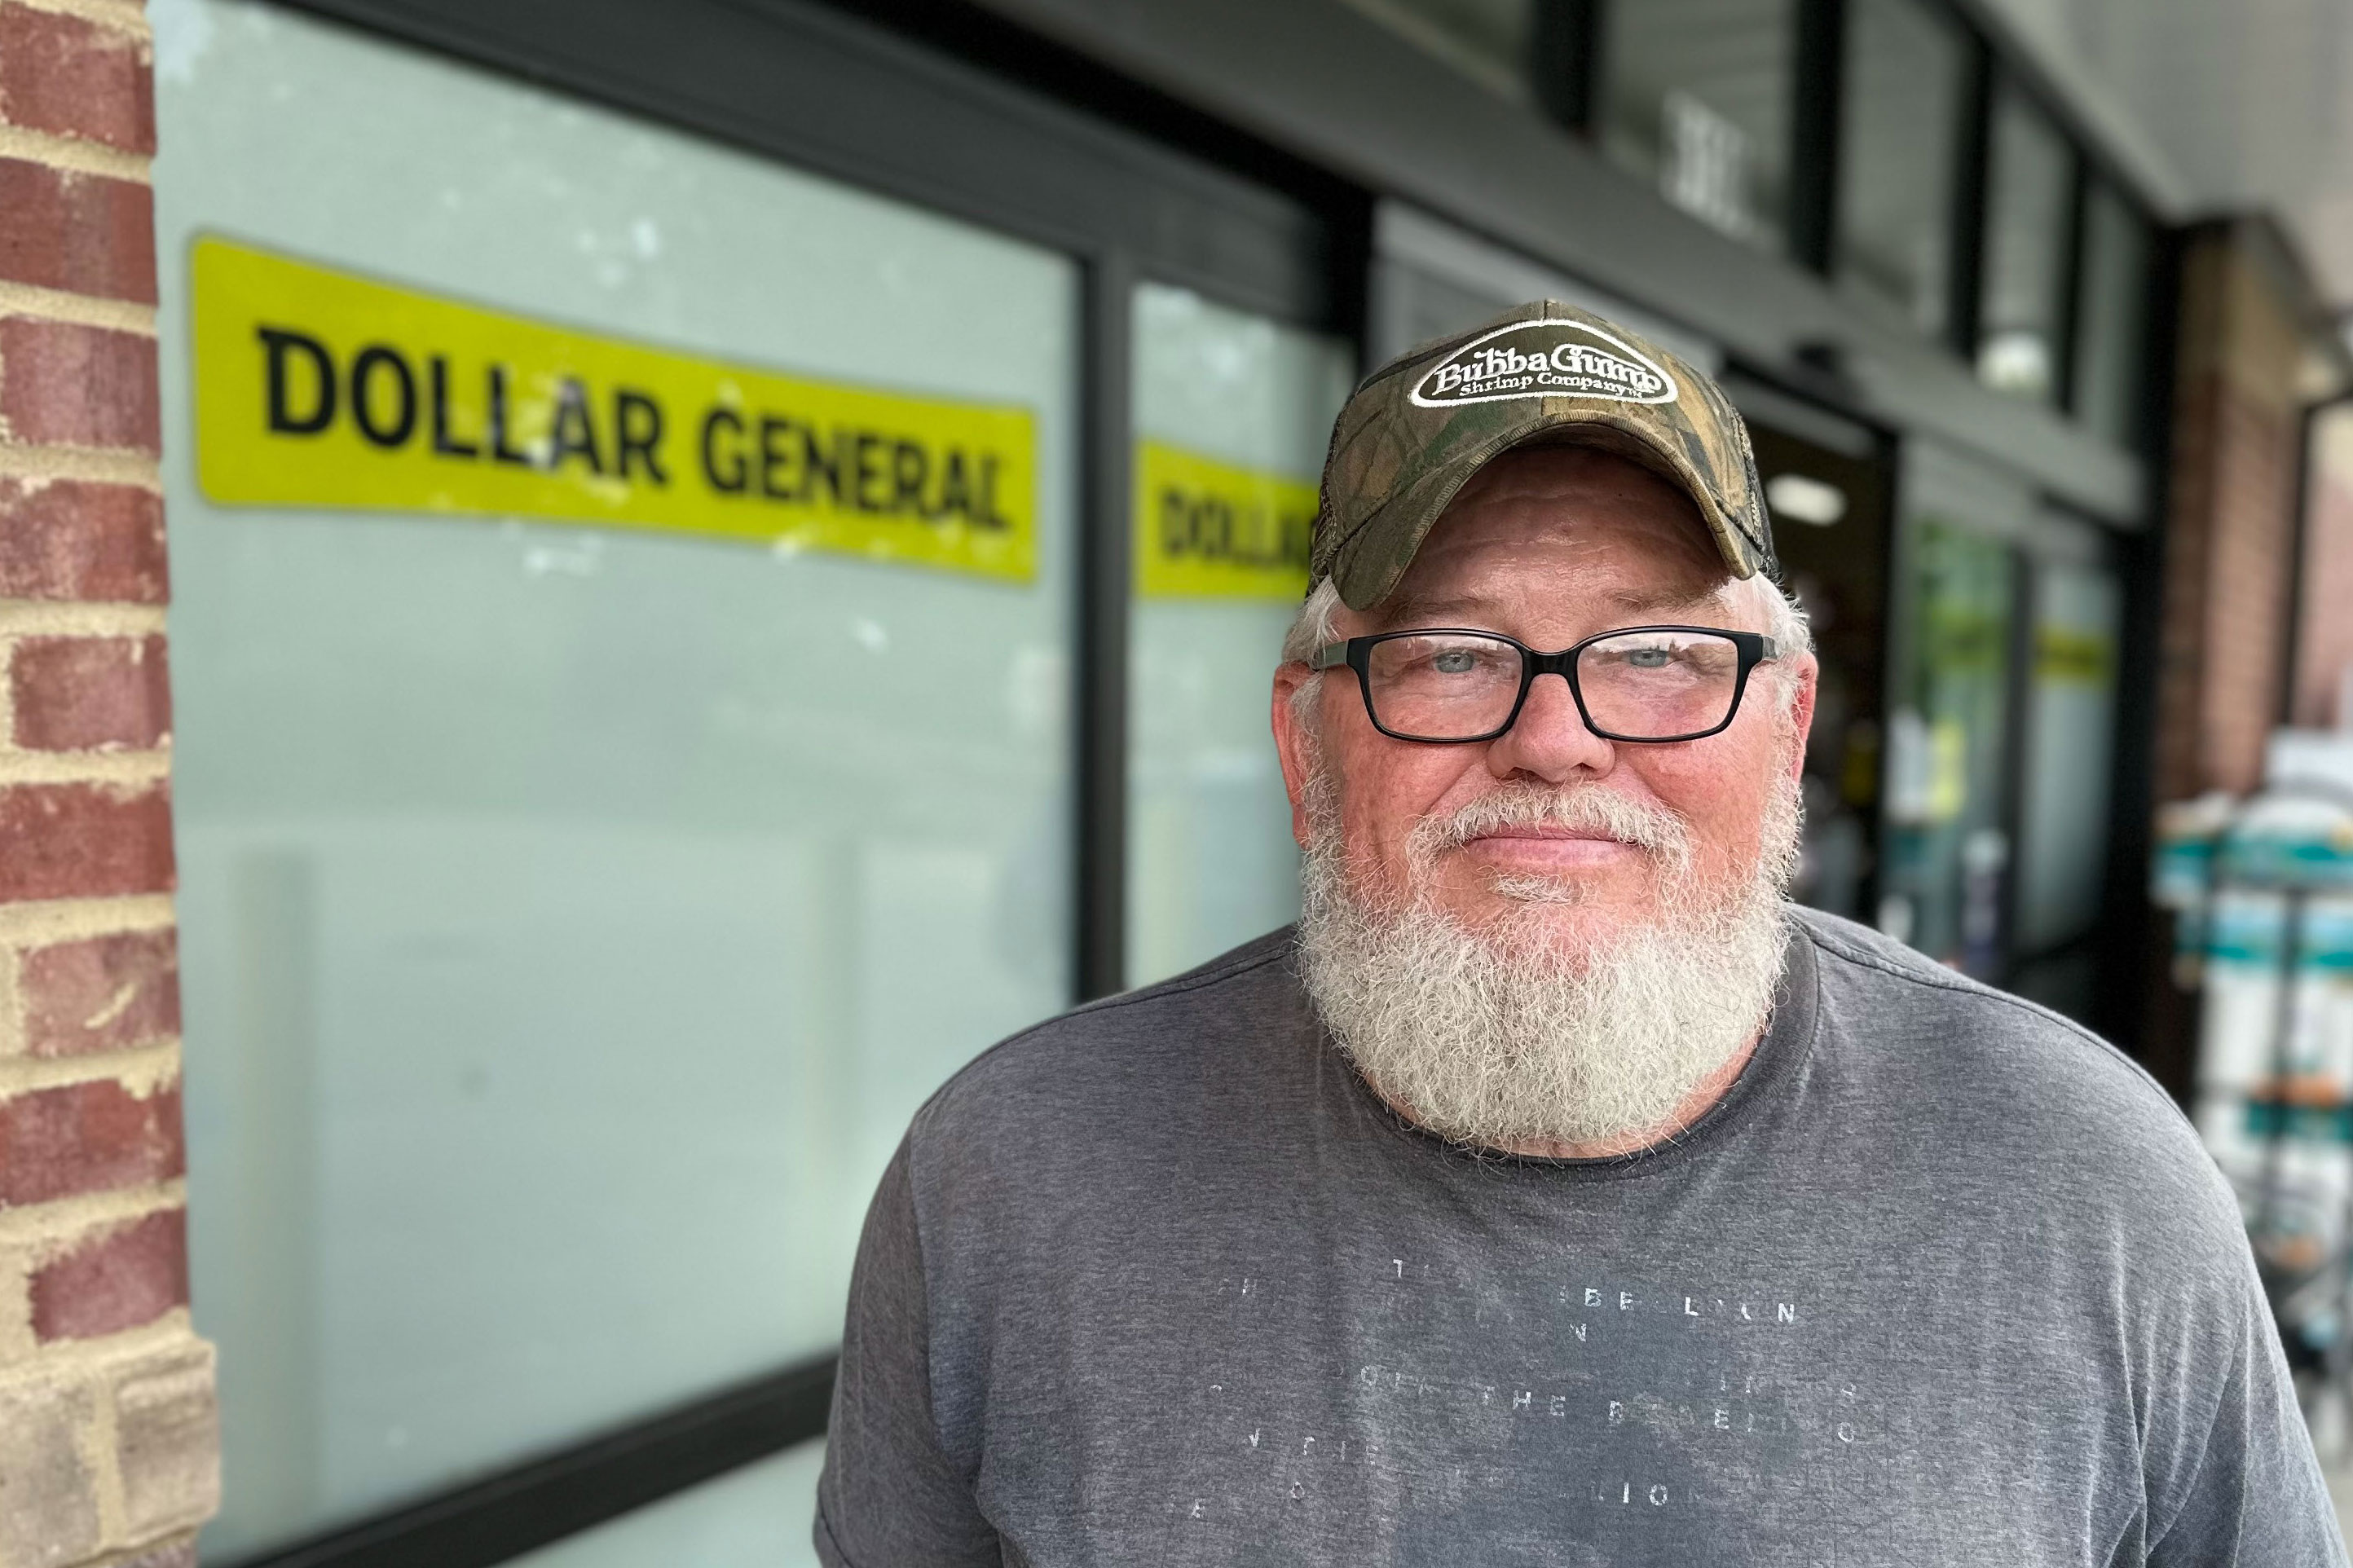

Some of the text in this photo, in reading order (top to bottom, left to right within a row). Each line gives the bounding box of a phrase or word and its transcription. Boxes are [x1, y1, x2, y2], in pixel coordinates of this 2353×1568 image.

[1432, 343, 1663, 396] Bubba Gump
[1459, 376, 1534, 397] Shrimp
[254, 323, 1012, 533] DOLLAR GENERAL
[1159, 487, 1314, 573] DOLLA
